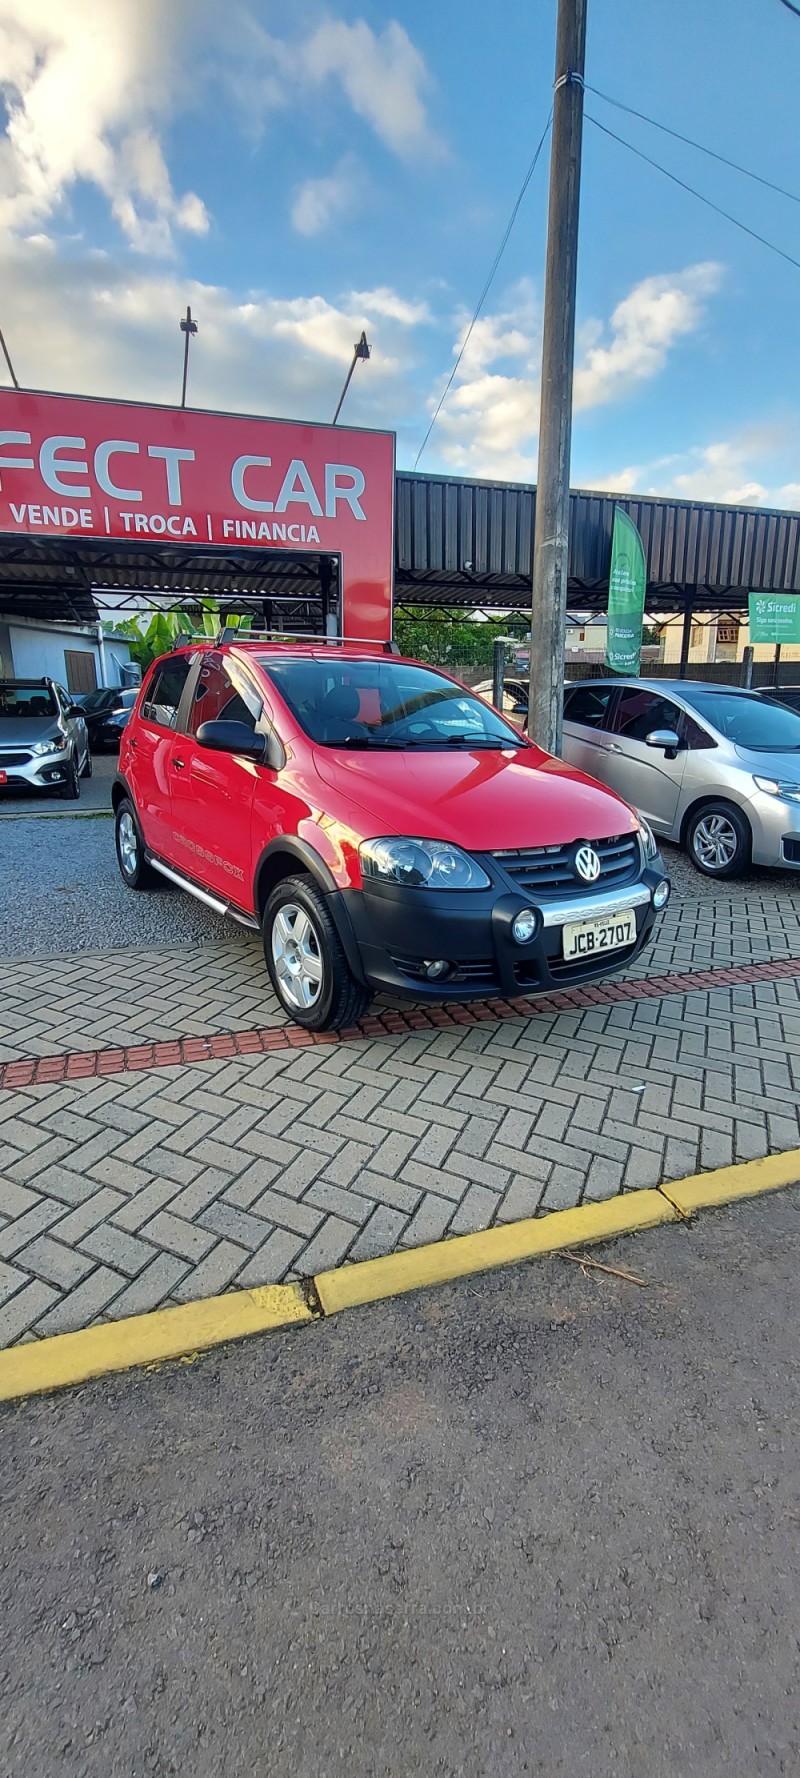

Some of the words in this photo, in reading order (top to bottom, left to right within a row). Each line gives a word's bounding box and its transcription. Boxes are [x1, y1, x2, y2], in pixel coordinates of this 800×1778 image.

[231, 455, 367, 520] CAR
[9, 503, 93, 528] VENDE
[119, 512, 197, 536] TROCA
[222, 519, 320, 543] FINANCIA
[767, 602, 796, 613] Sicredi
[172, 831, 244, 882] CROSSFOX
